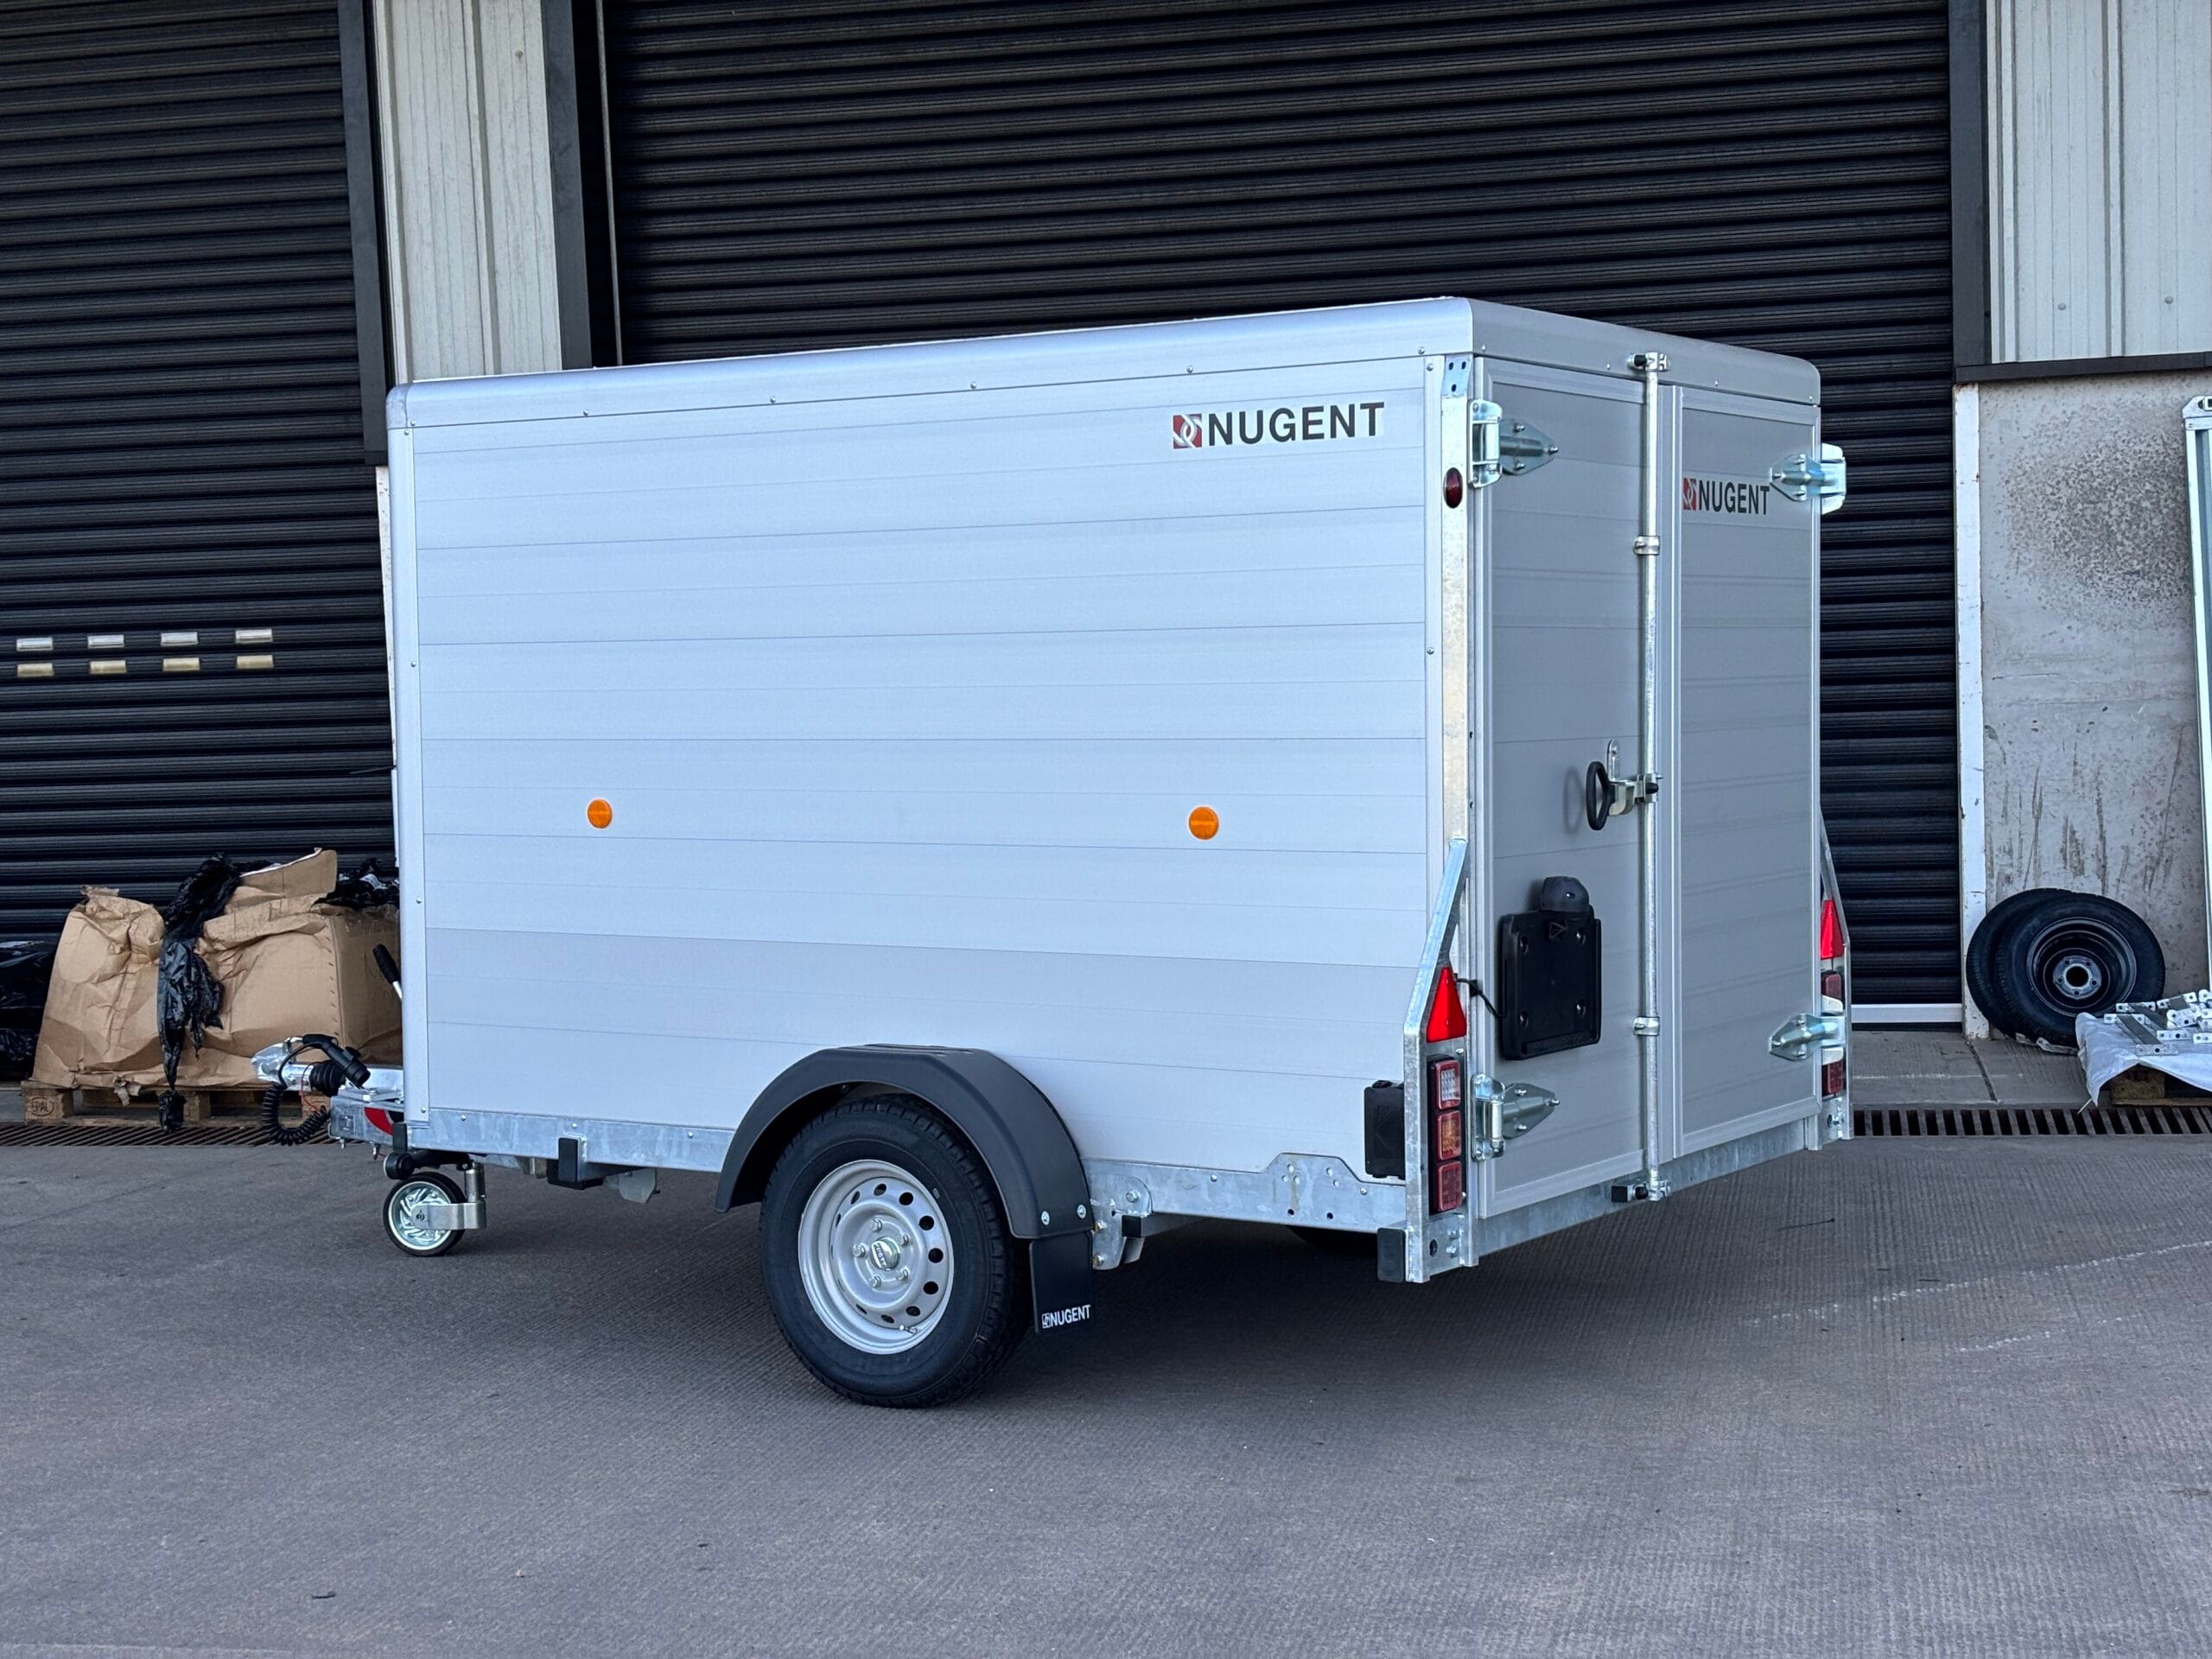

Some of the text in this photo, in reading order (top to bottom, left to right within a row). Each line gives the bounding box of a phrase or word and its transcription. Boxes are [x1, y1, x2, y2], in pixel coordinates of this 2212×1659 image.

[1209, 402, 1384, 446] NUGENT
[1699, 480, 1770, 514] NUGENT
[1051, 1304, 1090, 1327] NUGENT
